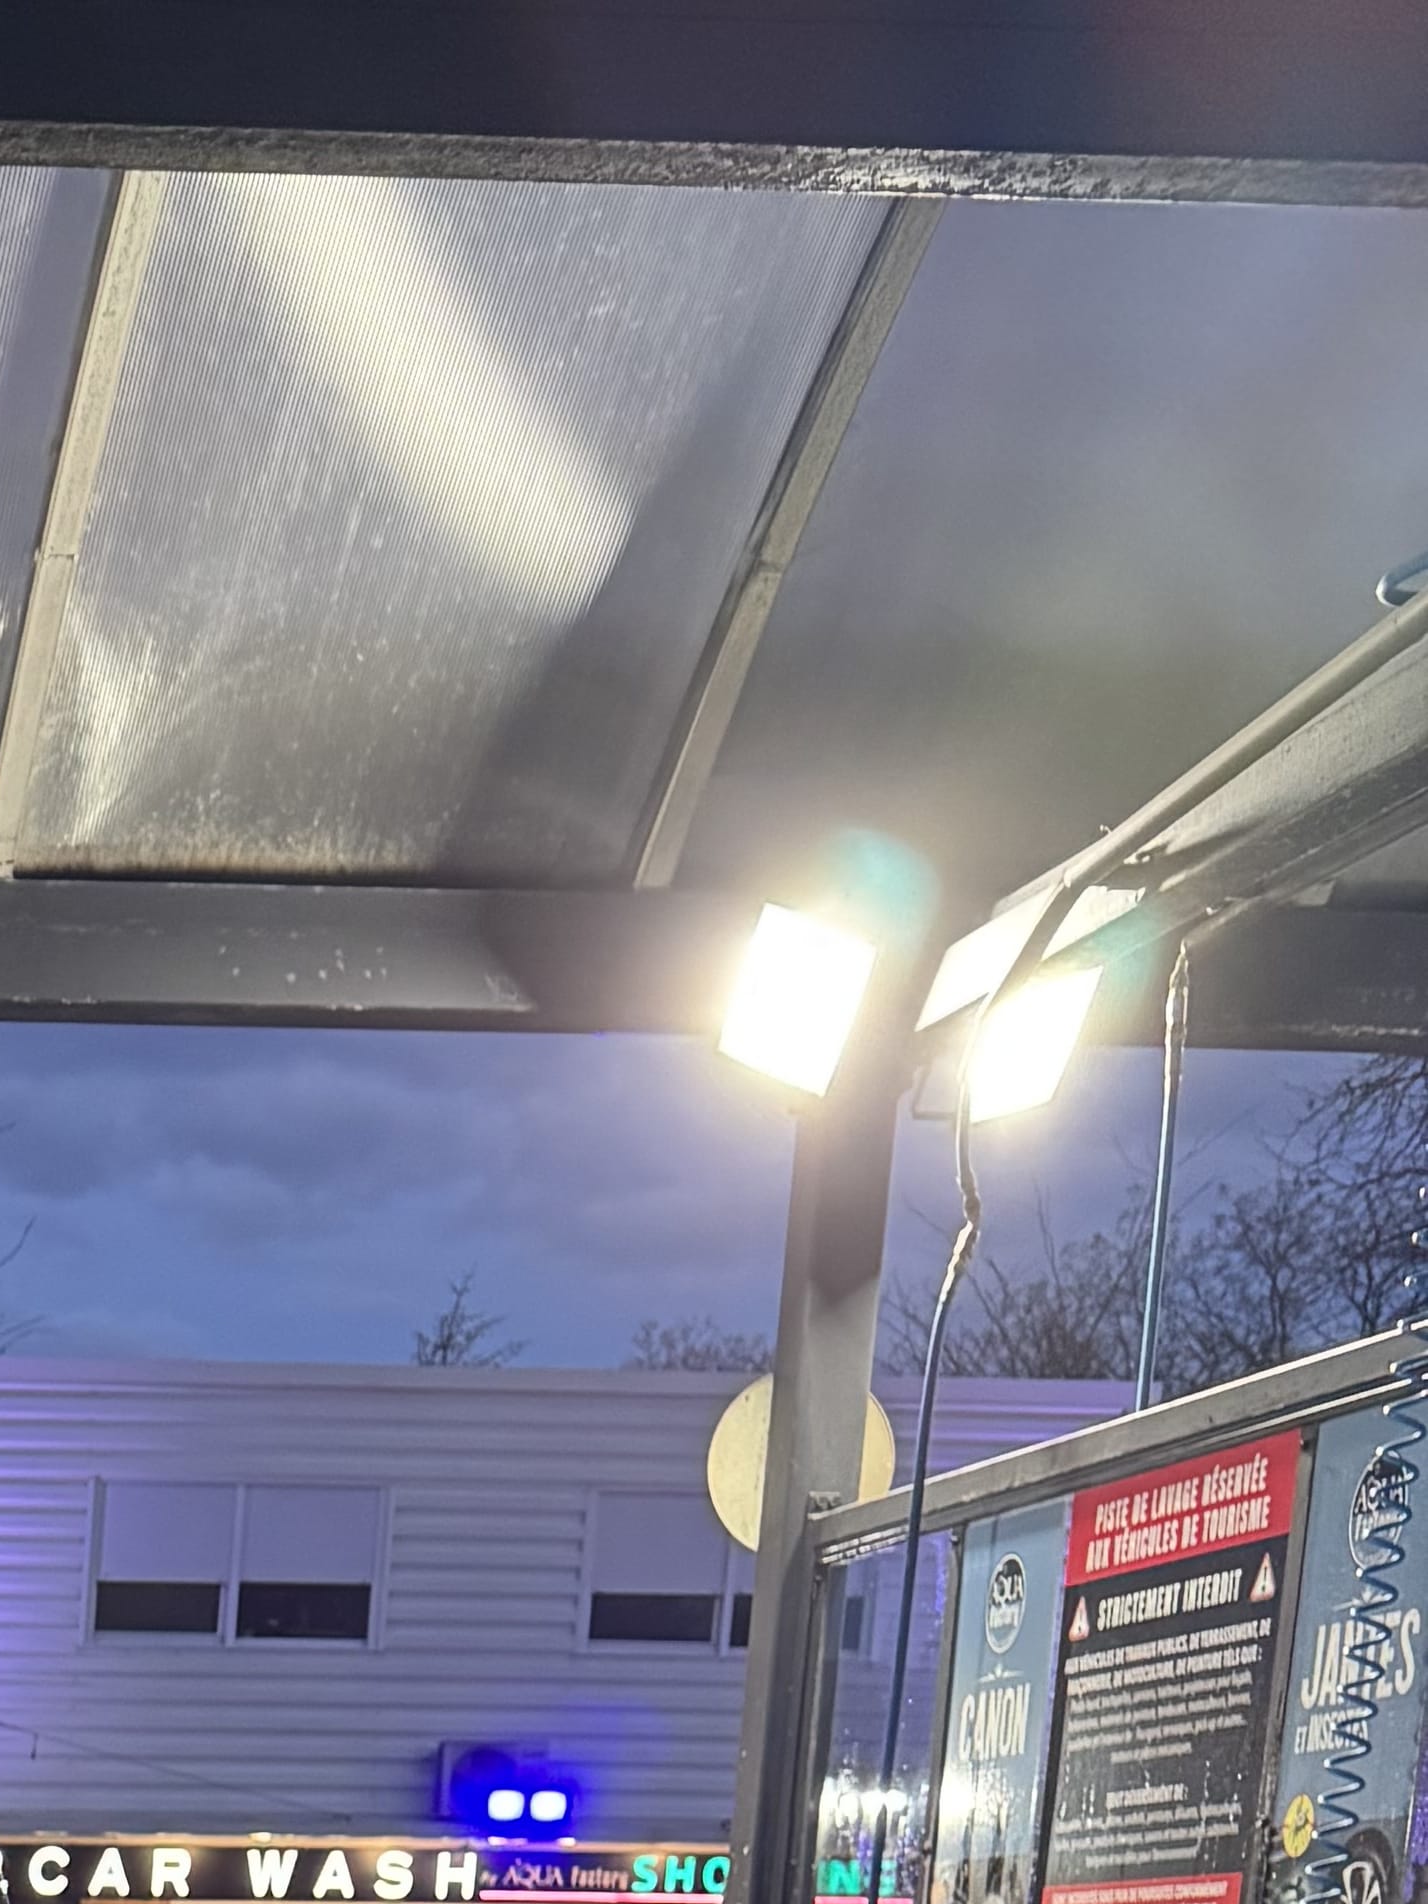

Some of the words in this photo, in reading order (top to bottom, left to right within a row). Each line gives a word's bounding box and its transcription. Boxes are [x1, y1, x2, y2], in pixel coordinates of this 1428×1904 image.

[1095, 1497, 1130, 1536] PISTE
[1132, 1491, 1148, 1526] DE
[1151, 1477, 1199, 1521] LAVAGE
[1202, 1452, 1269, 1507] RÉSERVÉE
[1086, 1537, 1111, 1573] AUX
[1113, 1520, 1179, 1567] VÉHICULES
[1181, 1516, 1199, 1549] DE
[1202, 1496, 1271, 1543] TOURISME
[1097, 1582, 1181, 1632] STRICTEMENT
[1182, 1568, 1243, 1613] INTERDIT
[959, 1682, 1031, 1761] CANON
[28, 1845, 192, 1898] CAR
[246, 1849, 478, 1900] WASH
[503, 1858, 564, 1889] AQUA
